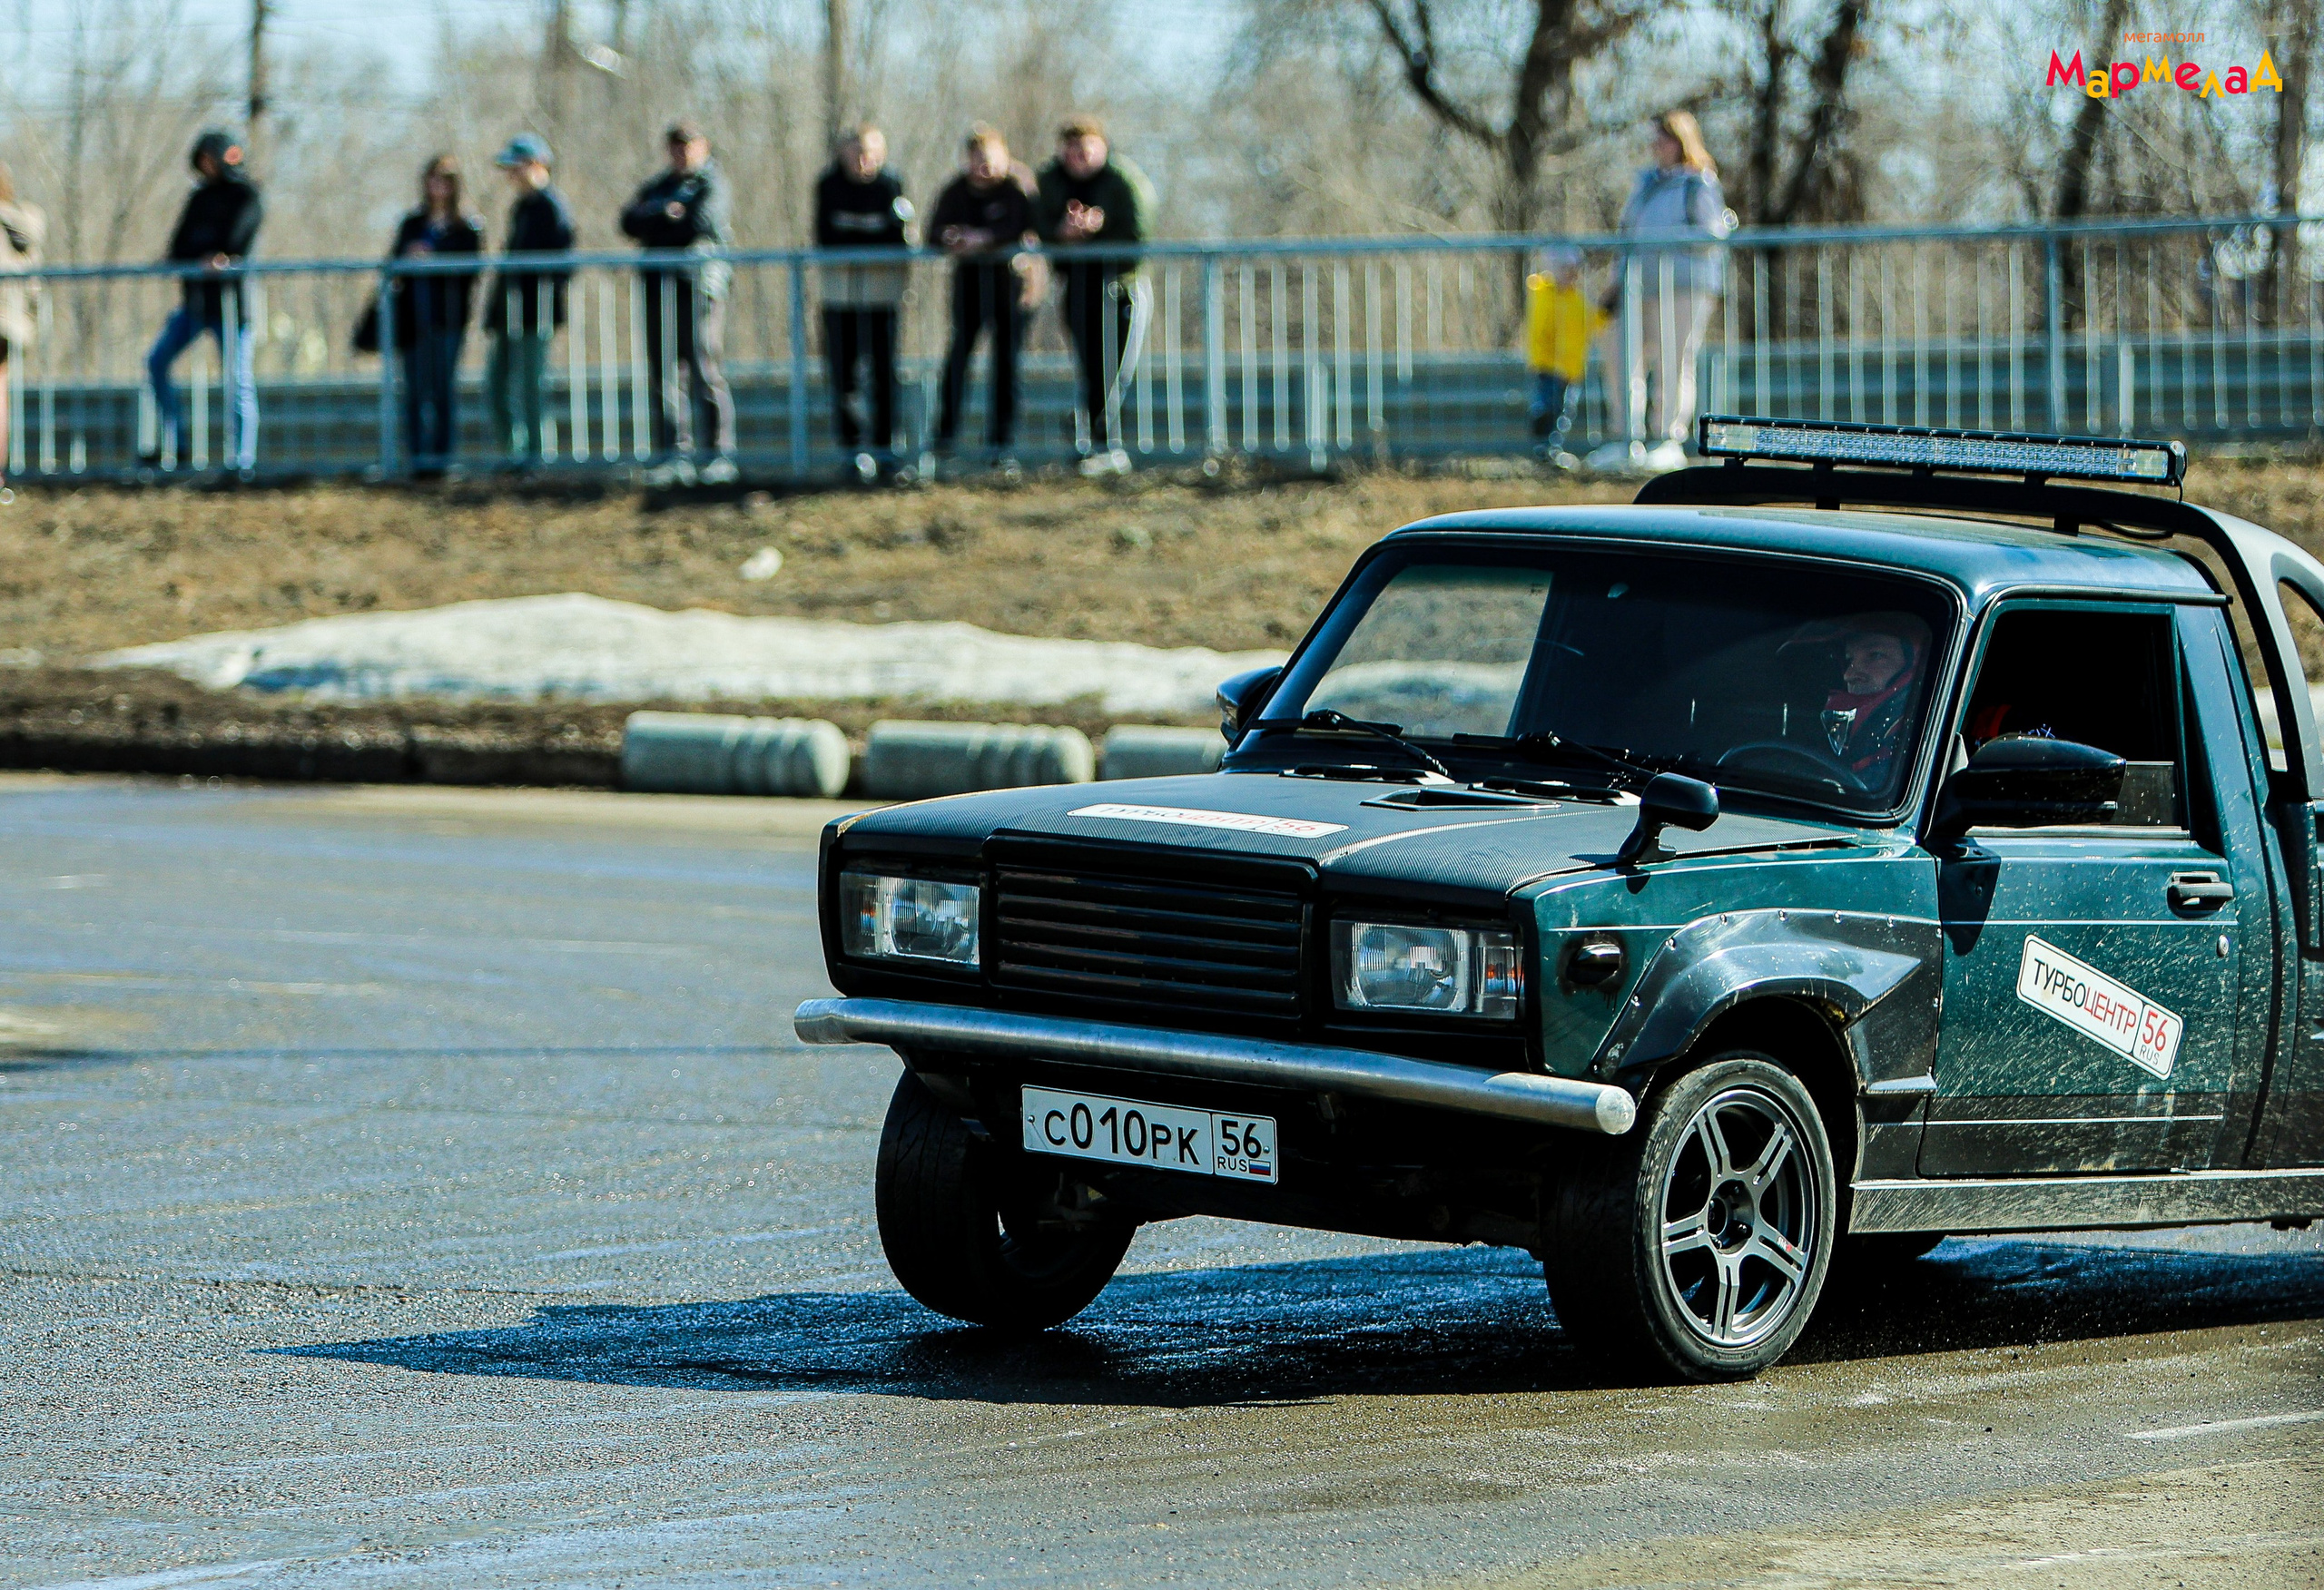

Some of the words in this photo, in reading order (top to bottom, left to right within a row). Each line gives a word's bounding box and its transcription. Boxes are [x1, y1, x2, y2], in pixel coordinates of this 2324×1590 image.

[2034, 957, 2137, 1035] ТУРБОЦЕНТР
[2142, 1009, 2169, 1052] 56
[2139, 1045, 2161, 1066] RUS
[1220, 1118, 1263, 1160] 56
[1216, 1155, 1248, 1173] RUS
